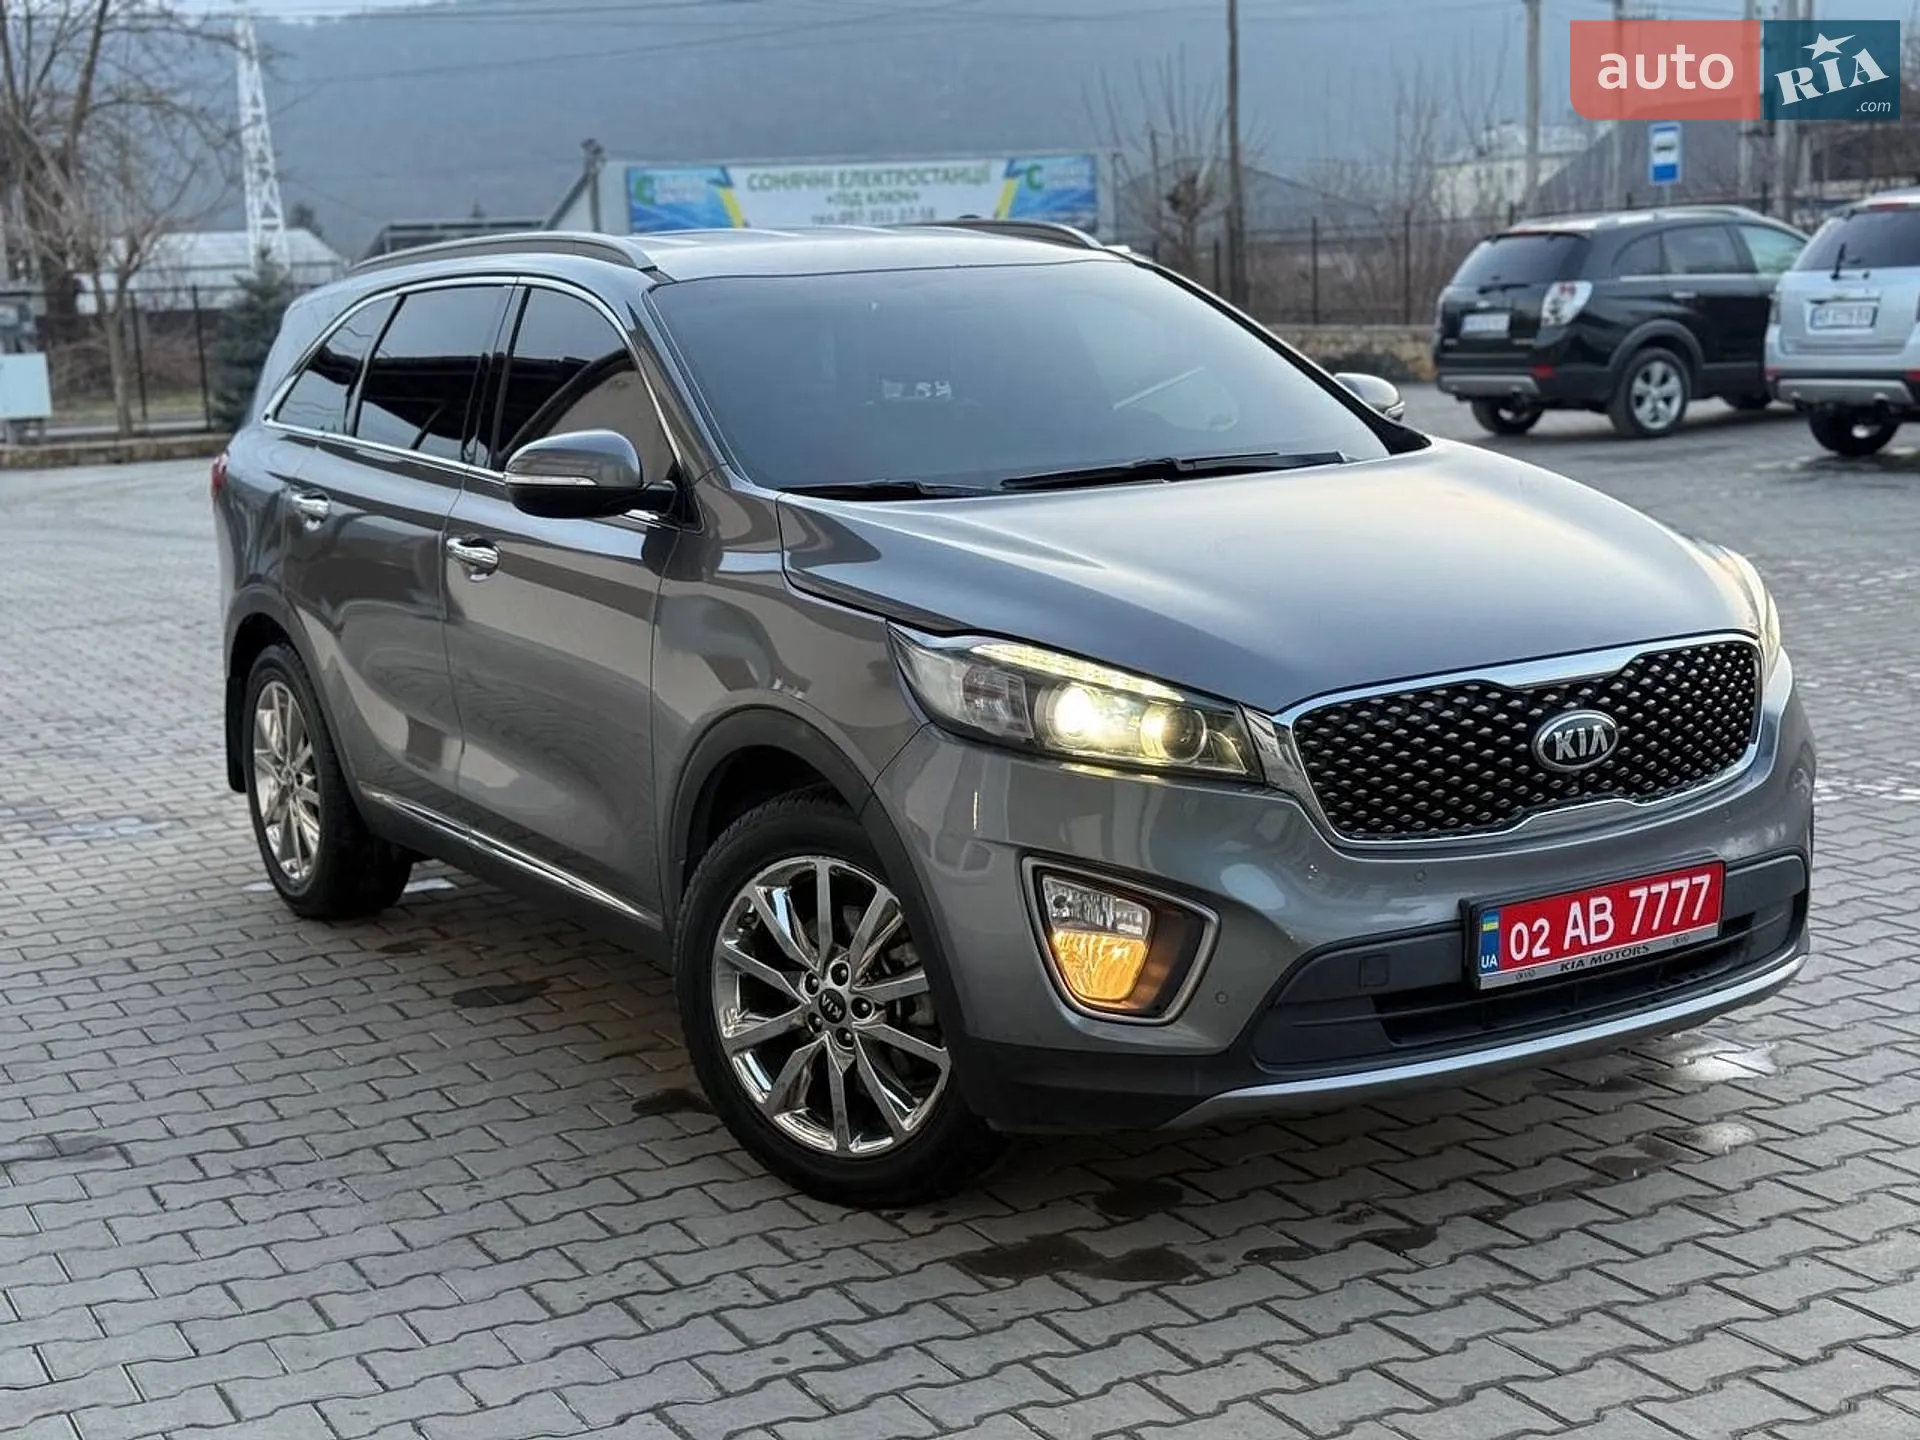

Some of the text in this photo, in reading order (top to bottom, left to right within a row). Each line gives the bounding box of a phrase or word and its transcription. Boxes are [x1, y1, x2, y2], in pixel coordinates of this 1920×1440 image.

[1553, 725, 1608, 760] KIA
[1509, 874, 1711, 961] 02 AB 7777
[1480, 953, 1498, 969] UA
[1560, 945, 1649, 972] KIA MOTORS
[822, 994, 842, 1019] KIA
